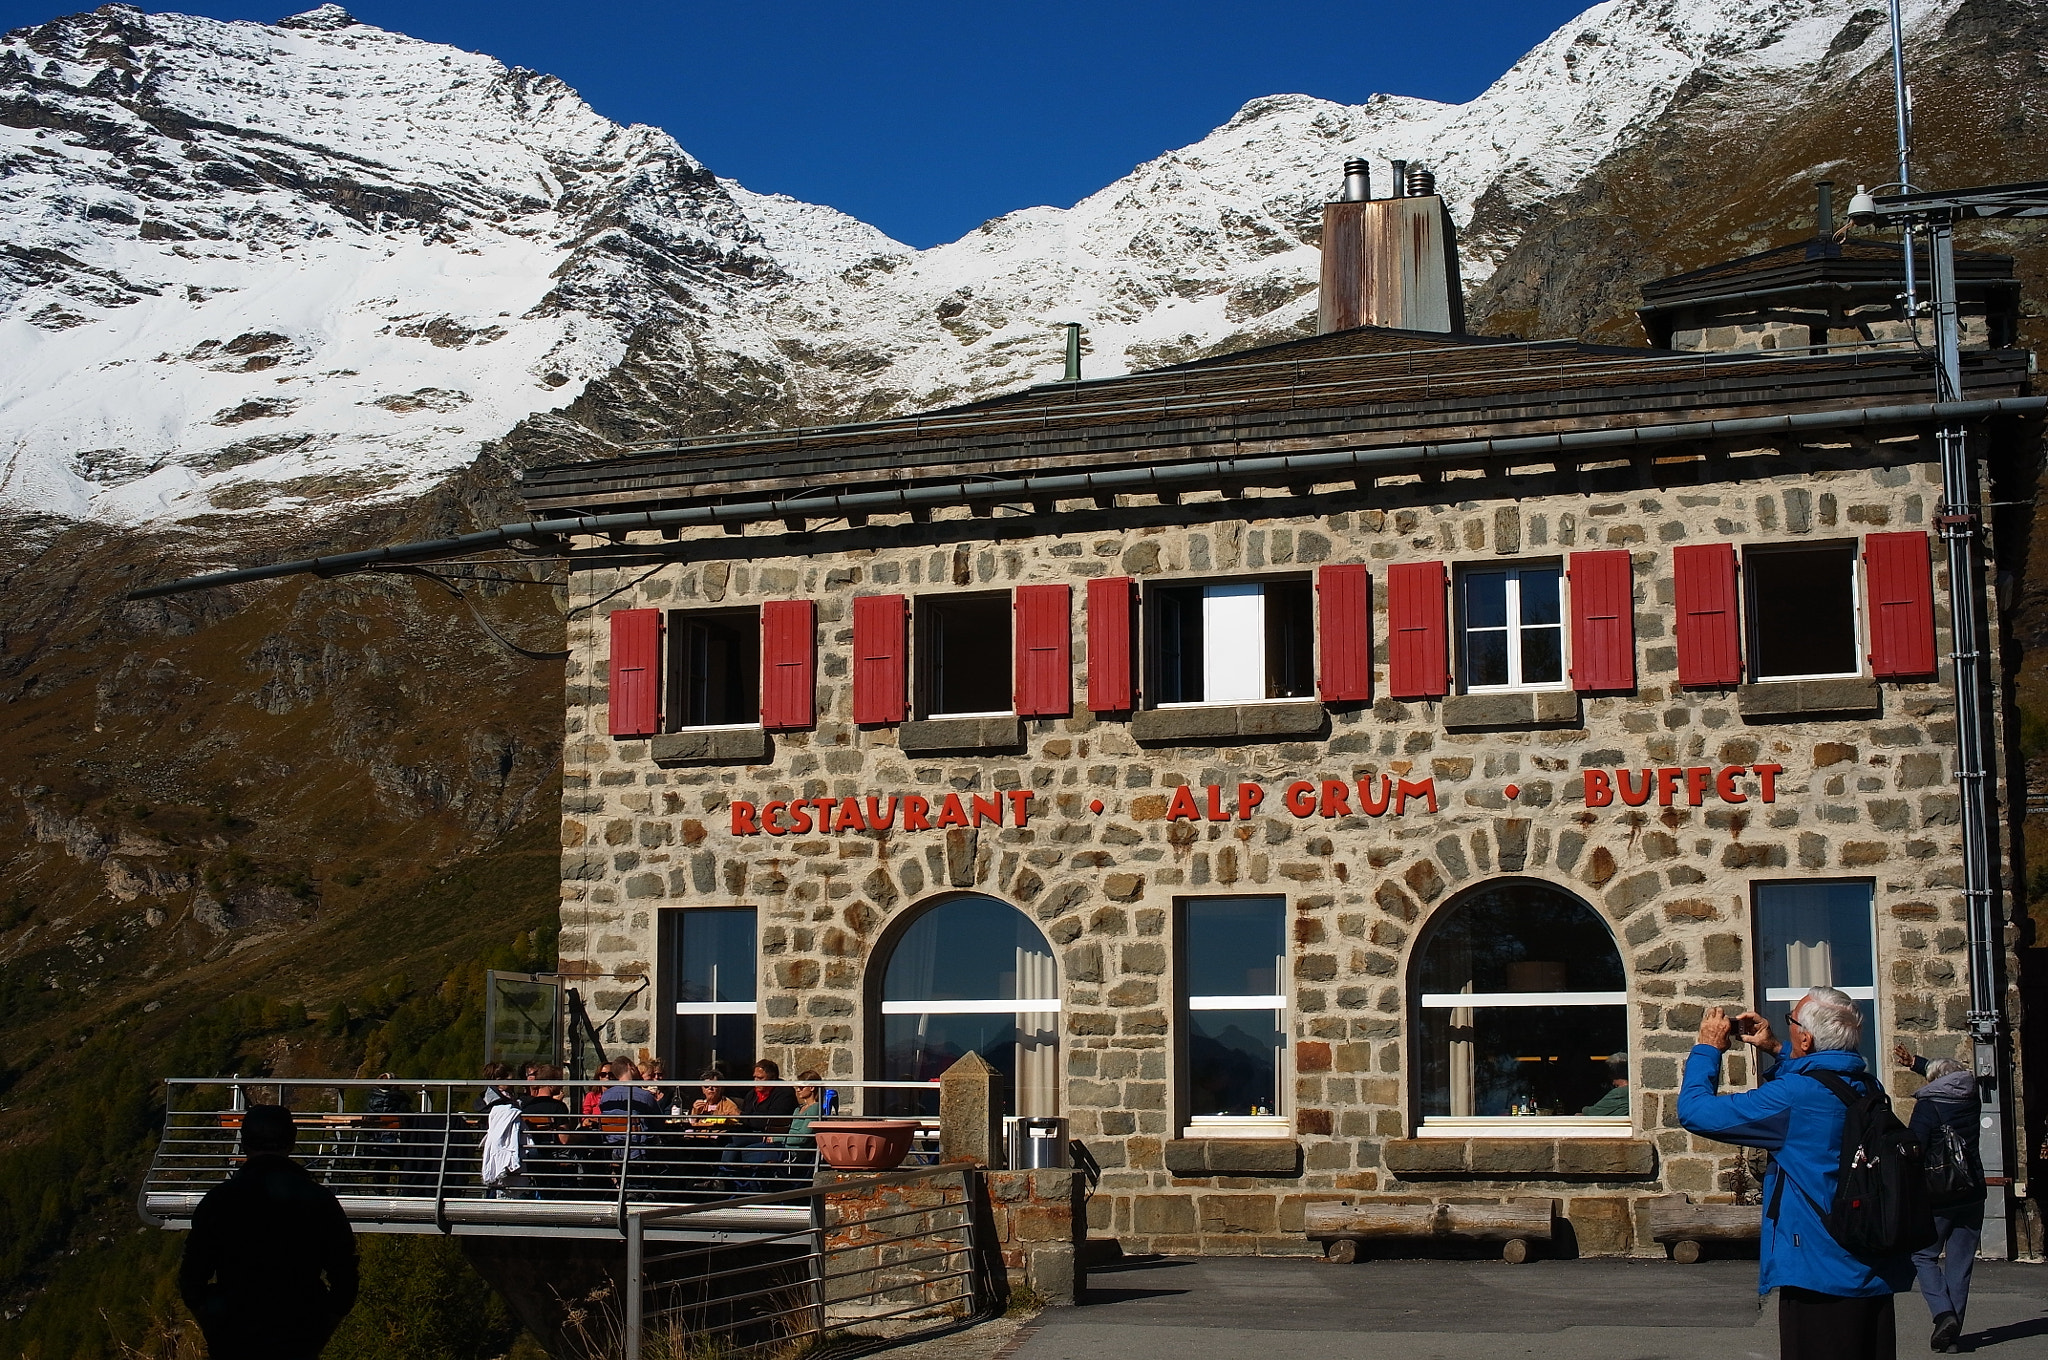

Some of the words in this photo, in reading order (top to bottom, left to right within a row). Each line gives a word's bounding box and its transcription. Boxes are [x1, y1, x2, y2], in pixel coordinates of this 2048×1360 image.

[731, 790, 1034, 836] RESTAURANT
[1166, 783, 1264, 821] ALP
[1285, 774, 1438, 819] GRÜM
[1583, 764, 1783, 808] BUFFET
